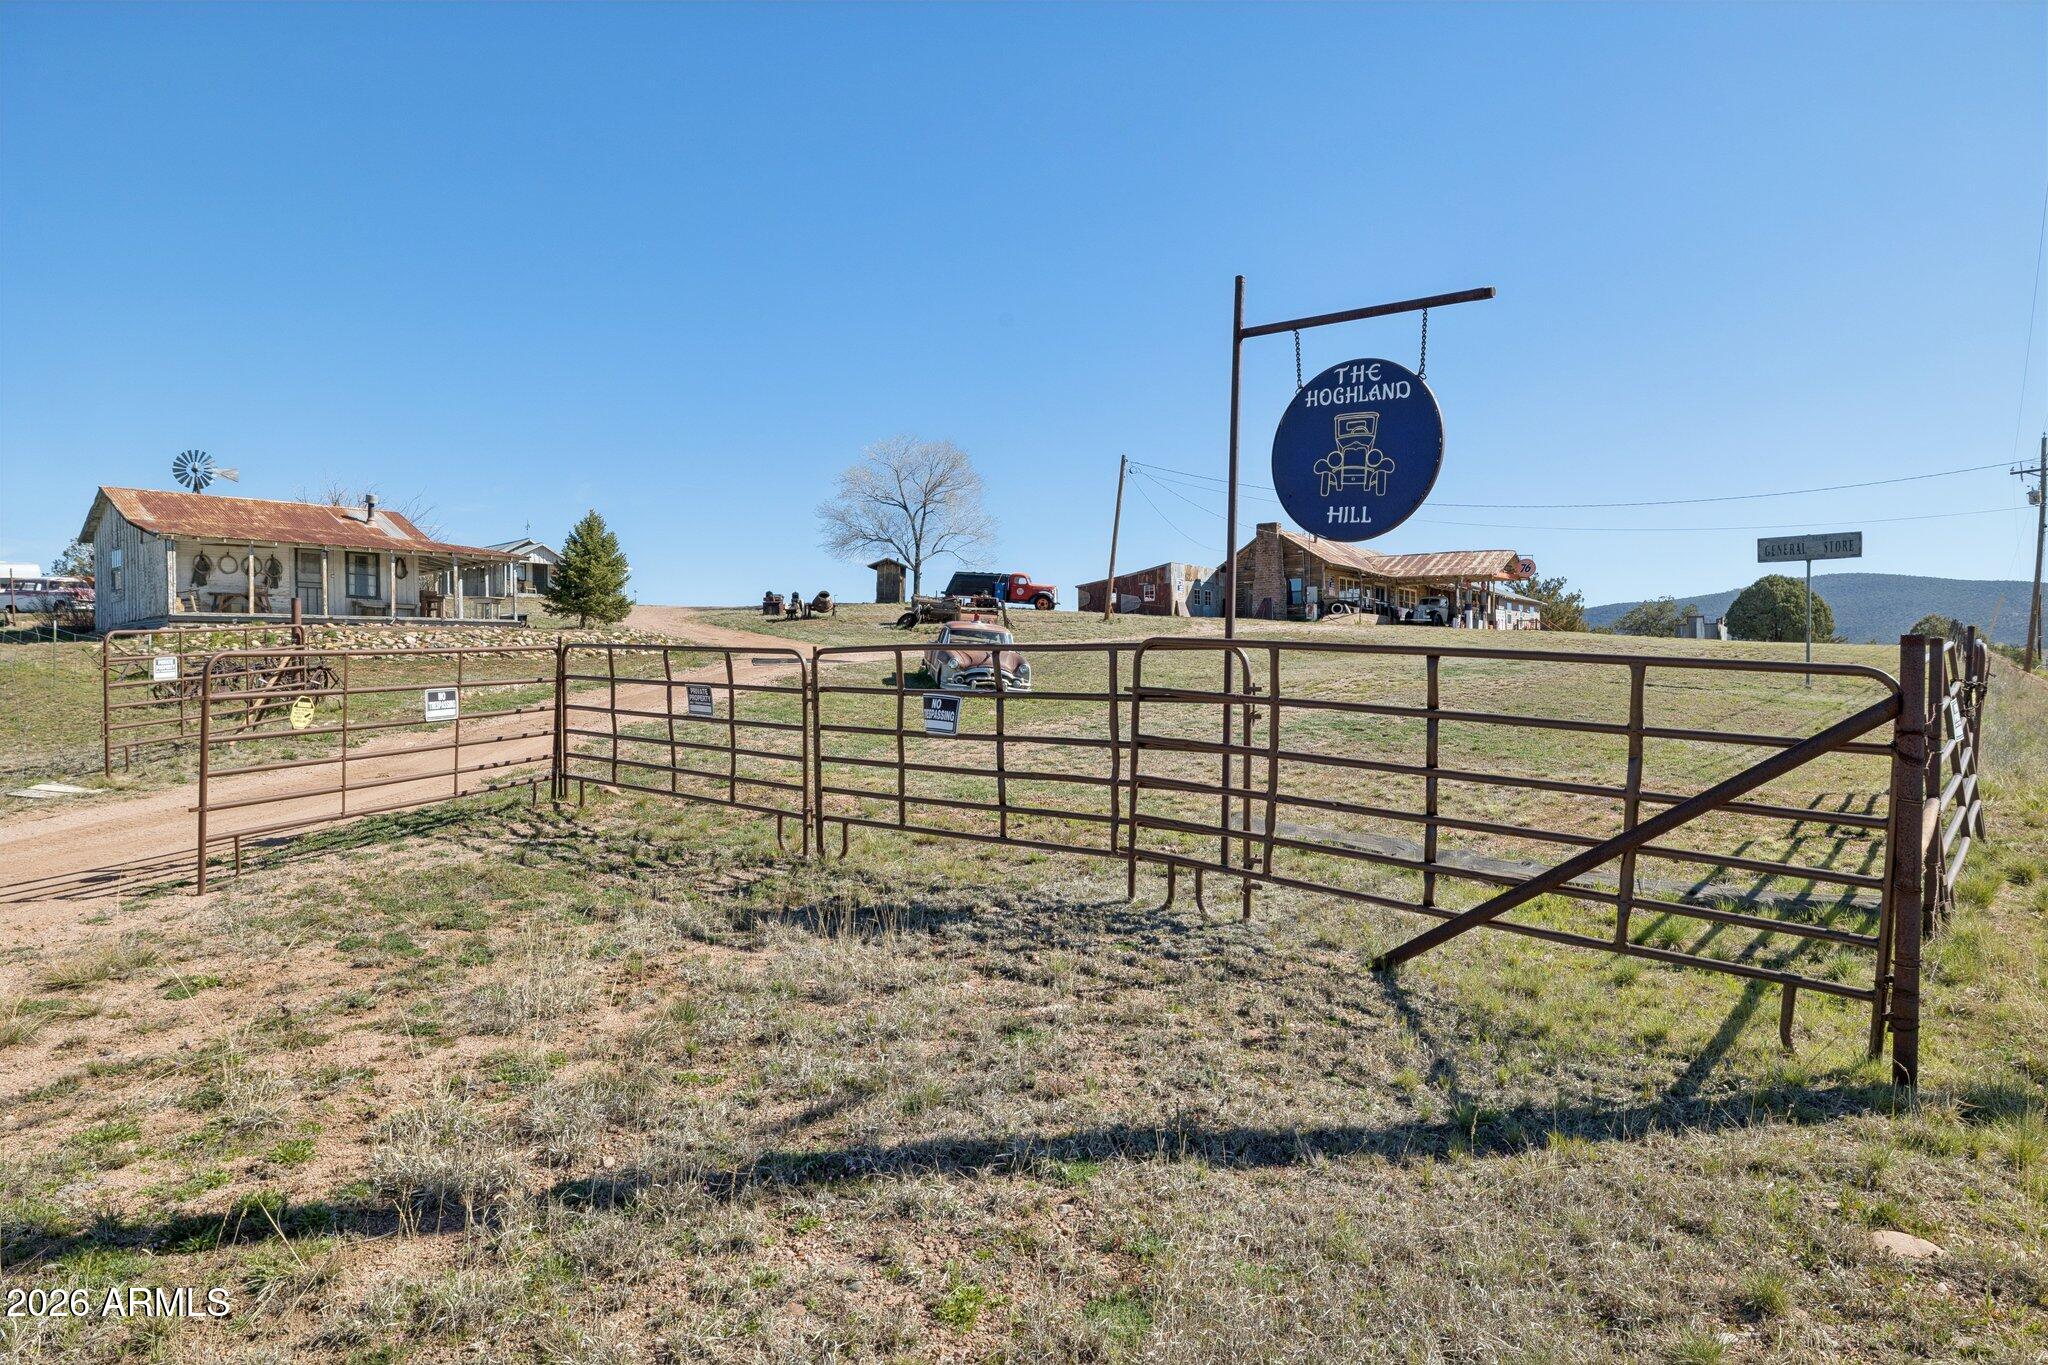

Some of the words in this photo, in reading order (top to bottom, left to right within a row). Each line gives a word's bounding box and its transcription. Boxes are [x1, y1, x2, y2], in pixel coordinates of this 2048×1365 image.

[1334, 363, 1381, 384] THE
[1305, 380, 1411, 407] HOGHLAND
[1327, 506, 1372, 523] HILL
[1764, 543, 1807, 557] GENERAL
[1823, 540, 1854, 553] STORE
[1520, 563, 1531, 572] 76
[437, 692, 446, 701] NO
[689, 687, 708, 695] PRIVATE
[688, 694, 711, 702] PROPERTY
[931, 698, 942, 709] NO
